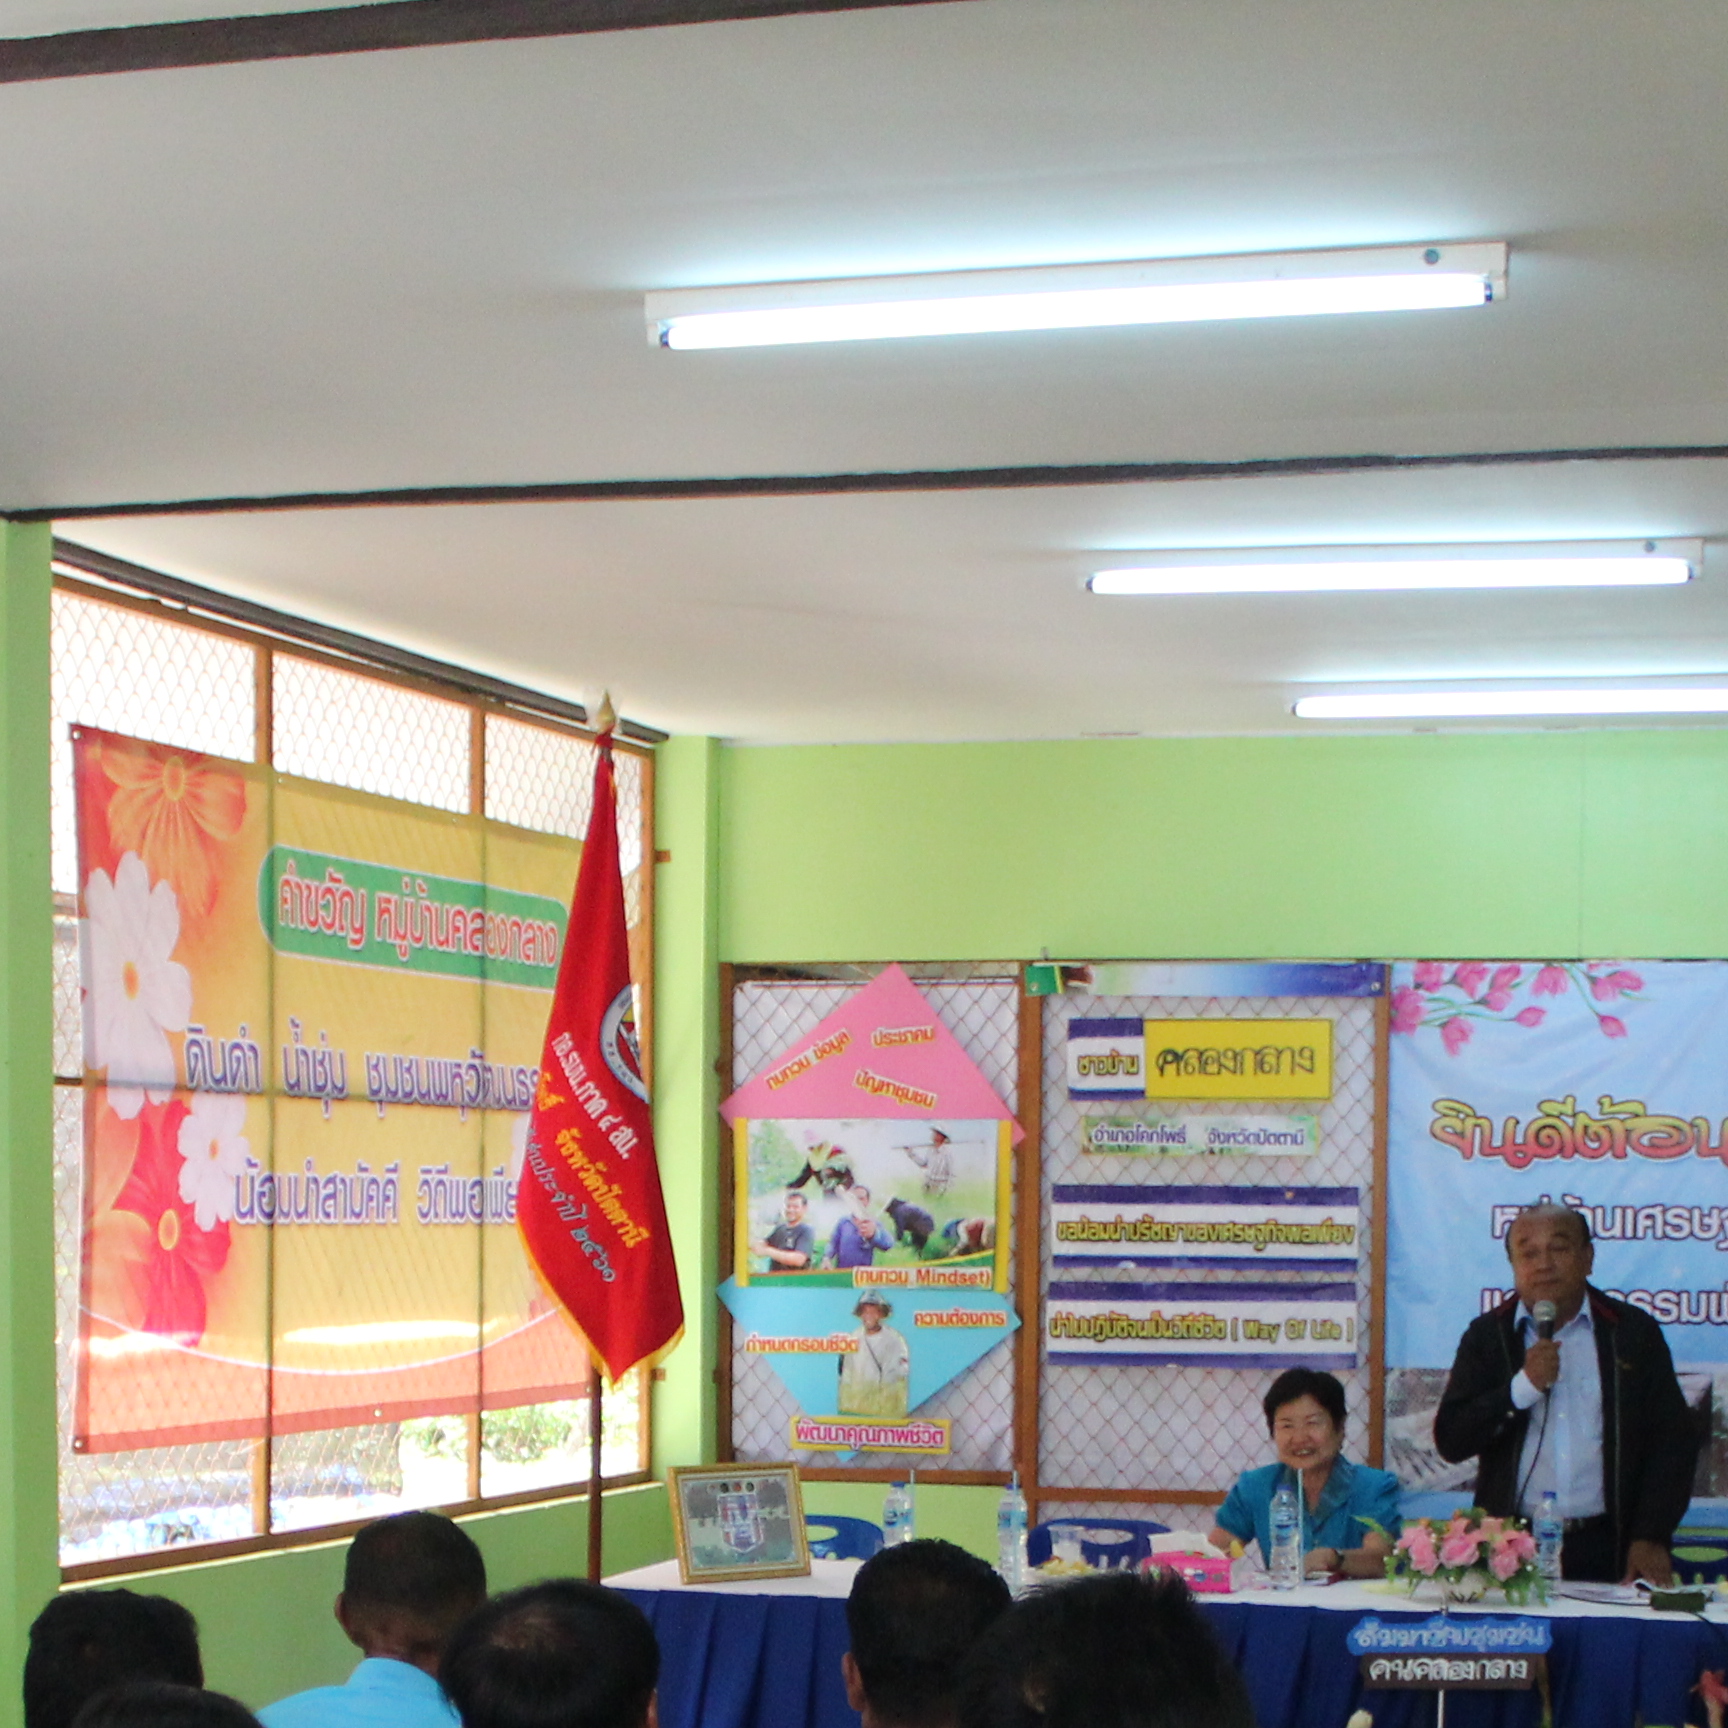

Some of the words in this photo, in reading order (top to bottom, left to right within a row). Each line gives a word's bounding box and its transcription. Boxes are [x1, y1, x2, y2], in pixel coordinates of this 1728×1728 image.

[279, 859, 366, 949] คำขวัญ
[375, 877, 558, 967] หมู่บ้านคลองกลาง
[184, 1025, 262, 1093] ดินดำ
[283, 1017, 347, 1119] น้ำชุ่ม
[915, 1268, 992, 1286] Mindset)
[914, 1308, 1006, 1327] ความต้องการ
